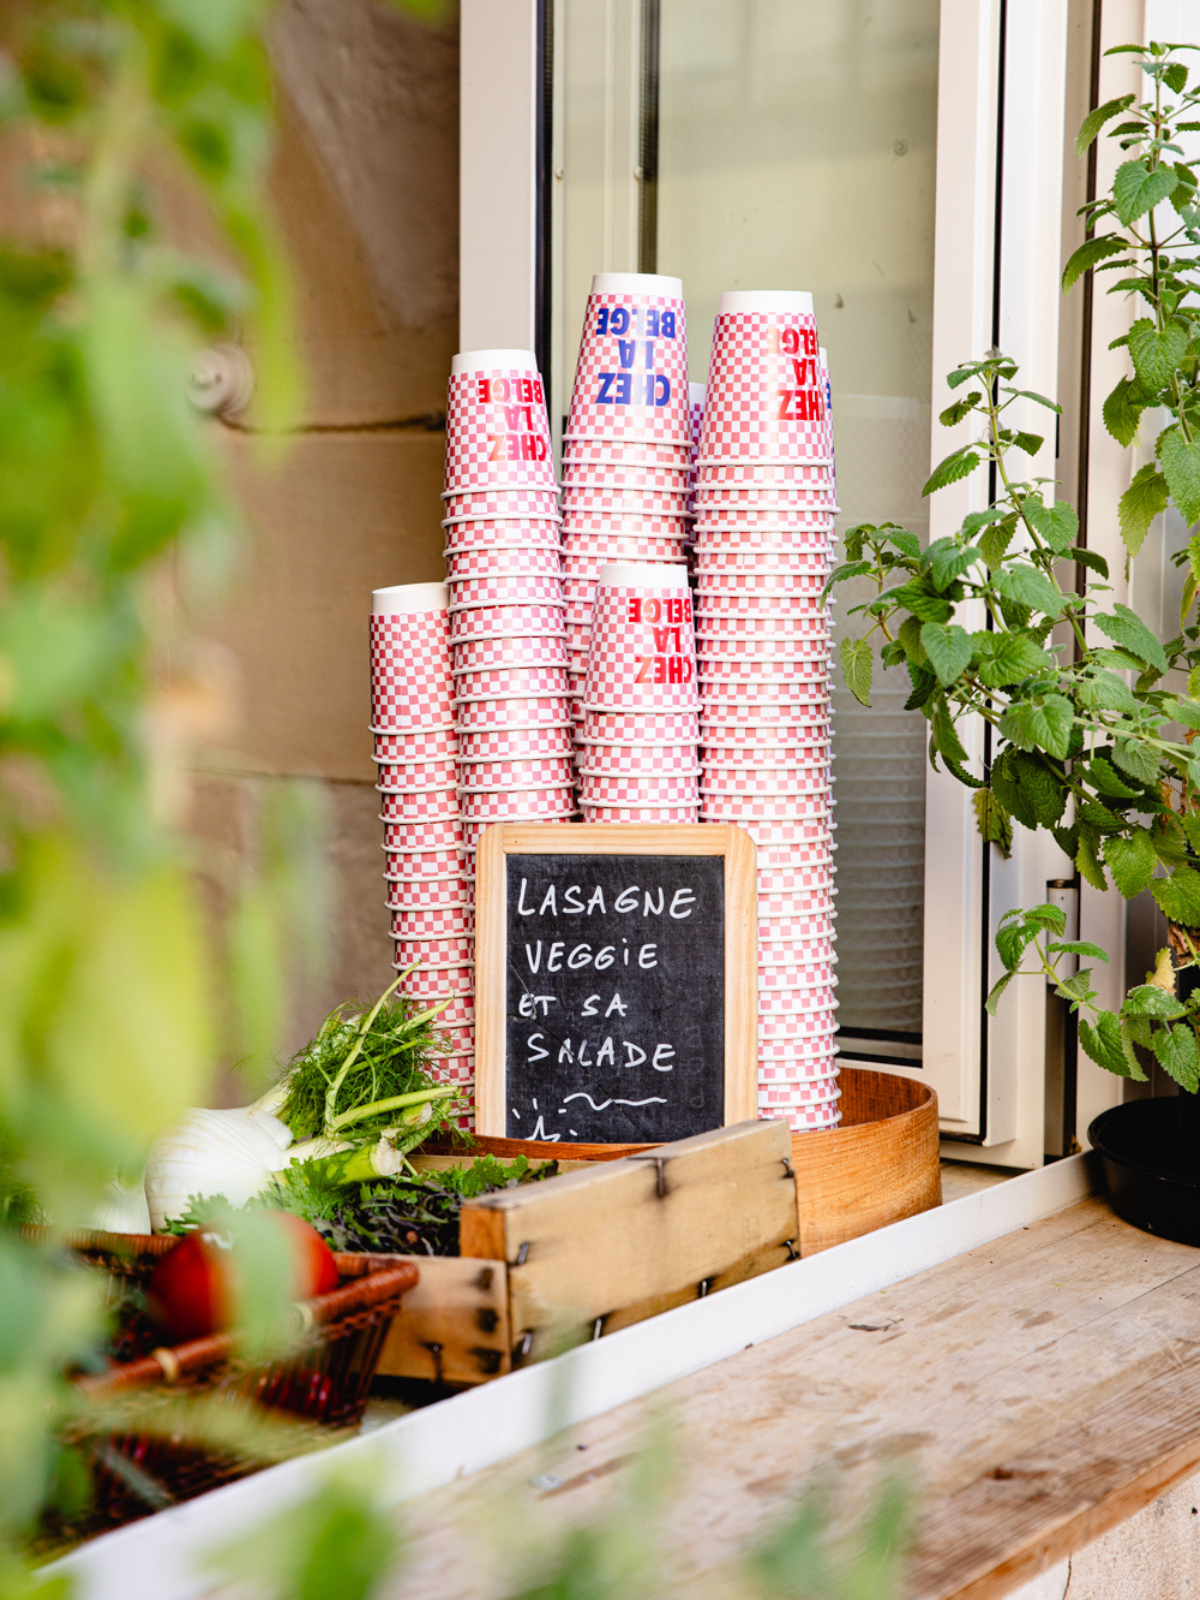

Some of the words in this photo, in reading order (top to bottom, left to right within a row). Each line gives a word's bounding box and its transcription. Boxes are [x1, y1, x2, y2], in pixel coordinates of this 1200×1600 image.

[595, 307, 676, 339] BELGE
[618, 339, 654, 370] LA
[765, 328, 820, 355] ELGE
[791, 358, 817, 386] LA
[478, 378, 543, 404] BELGE
[595, 373, 671, 407] CHEZ
[503, 406, 533, 431] LA
[487, 434, 547, 462] CHEZ
[628, 598, 692, 623] BELGE
[652, 627, 681, 653] LA
[634, 656, 692, 684] CHEZ
[517, 877, 697, 919] LASAGNE
[517, 993, 557, 1018] ET
[581, 992, 629, 1018] SA
[526, 1032, 677, 1072] SALADE
